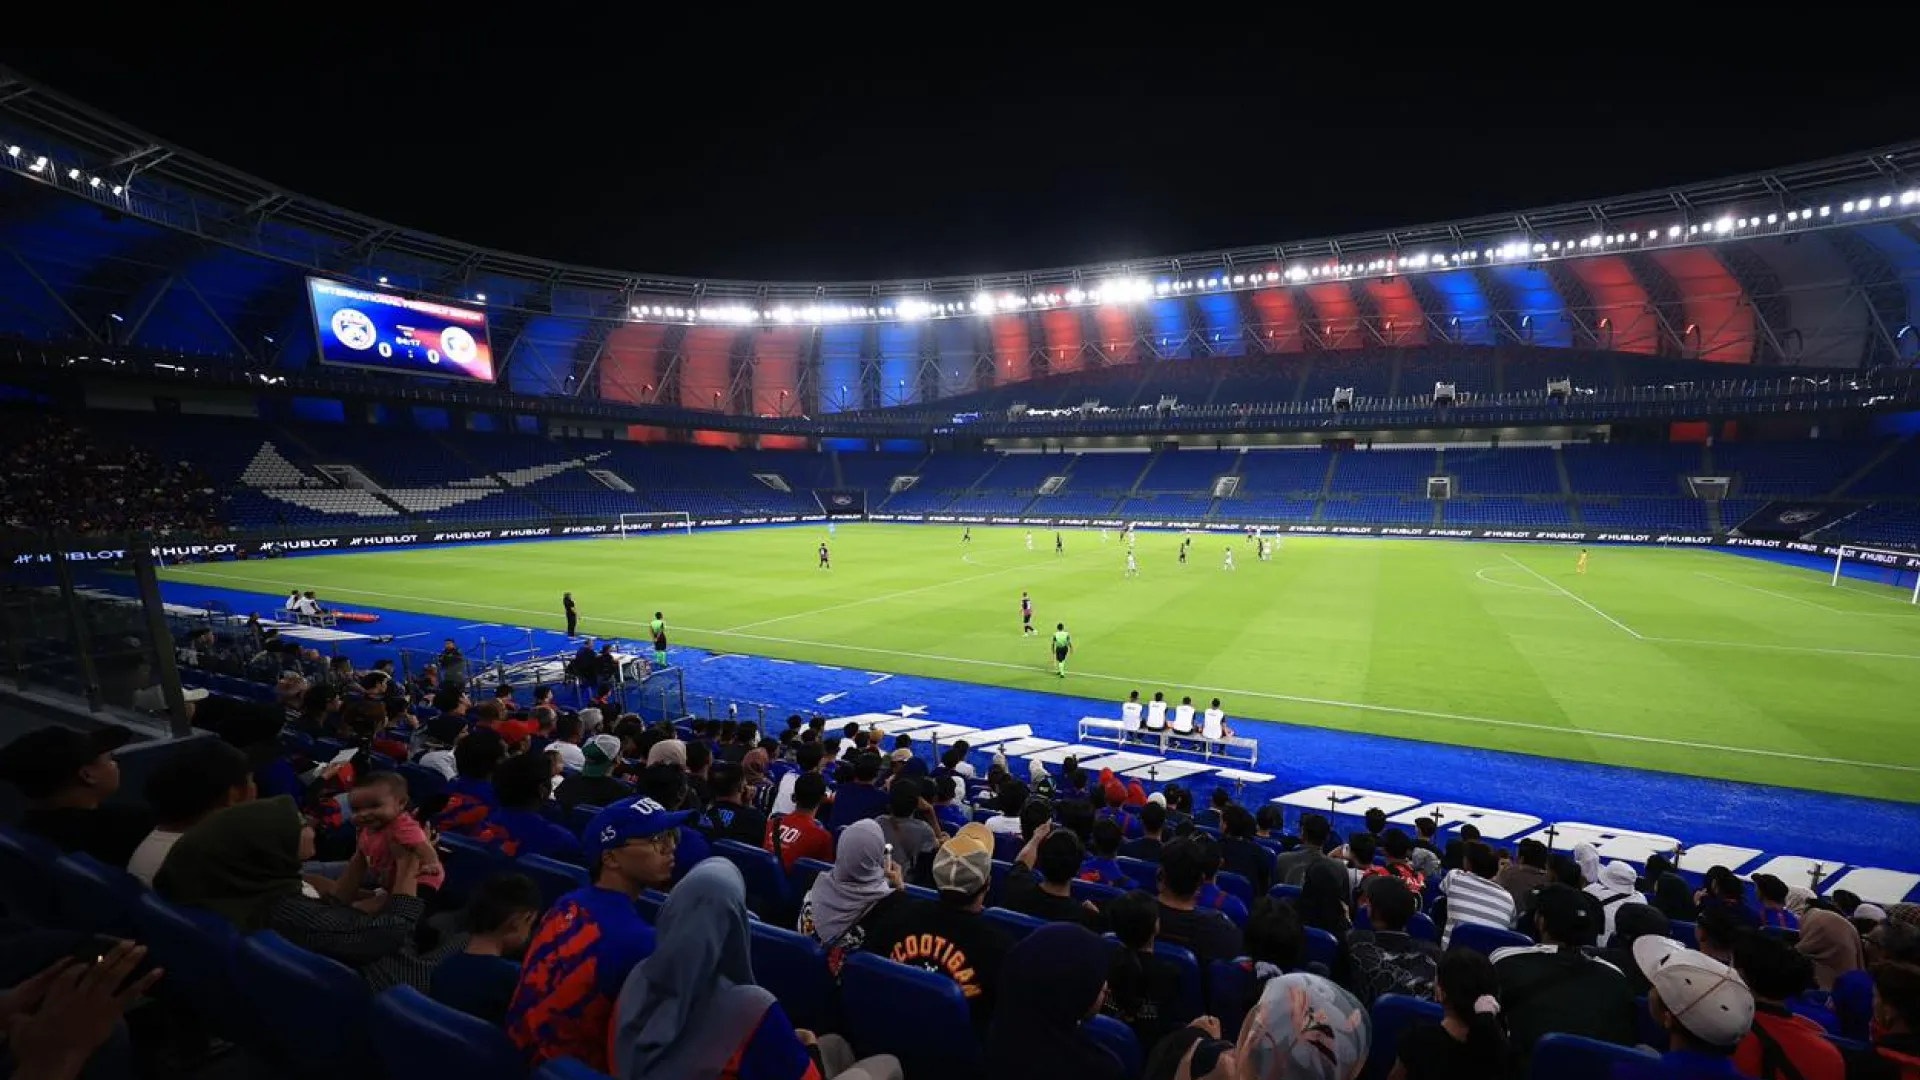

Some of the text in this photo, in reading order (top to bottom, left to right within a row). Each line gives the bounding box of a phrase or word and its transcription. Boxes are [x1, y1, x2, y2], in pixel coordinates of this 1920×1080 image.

[378, 342, 440, 364] 0 0
[510, 528, 550, 536] HUBLOT
[572, 525, 606, 533] HUBLOT
[364, 534, 418, 544] HUBLOT
[446, 530, 491, 540] HUBLOT
[1669, 536, 1713, 544] HUBLOT
[277, 538, 338, 549] HUBLOT
[1738, 539, 1781, 548] HUBLOT
[1793, 542, 1817, 552] HUBLOT
[38, 550, 126, 562] HBLOT
[1866, 552, 1897, 564] HUBLOT
